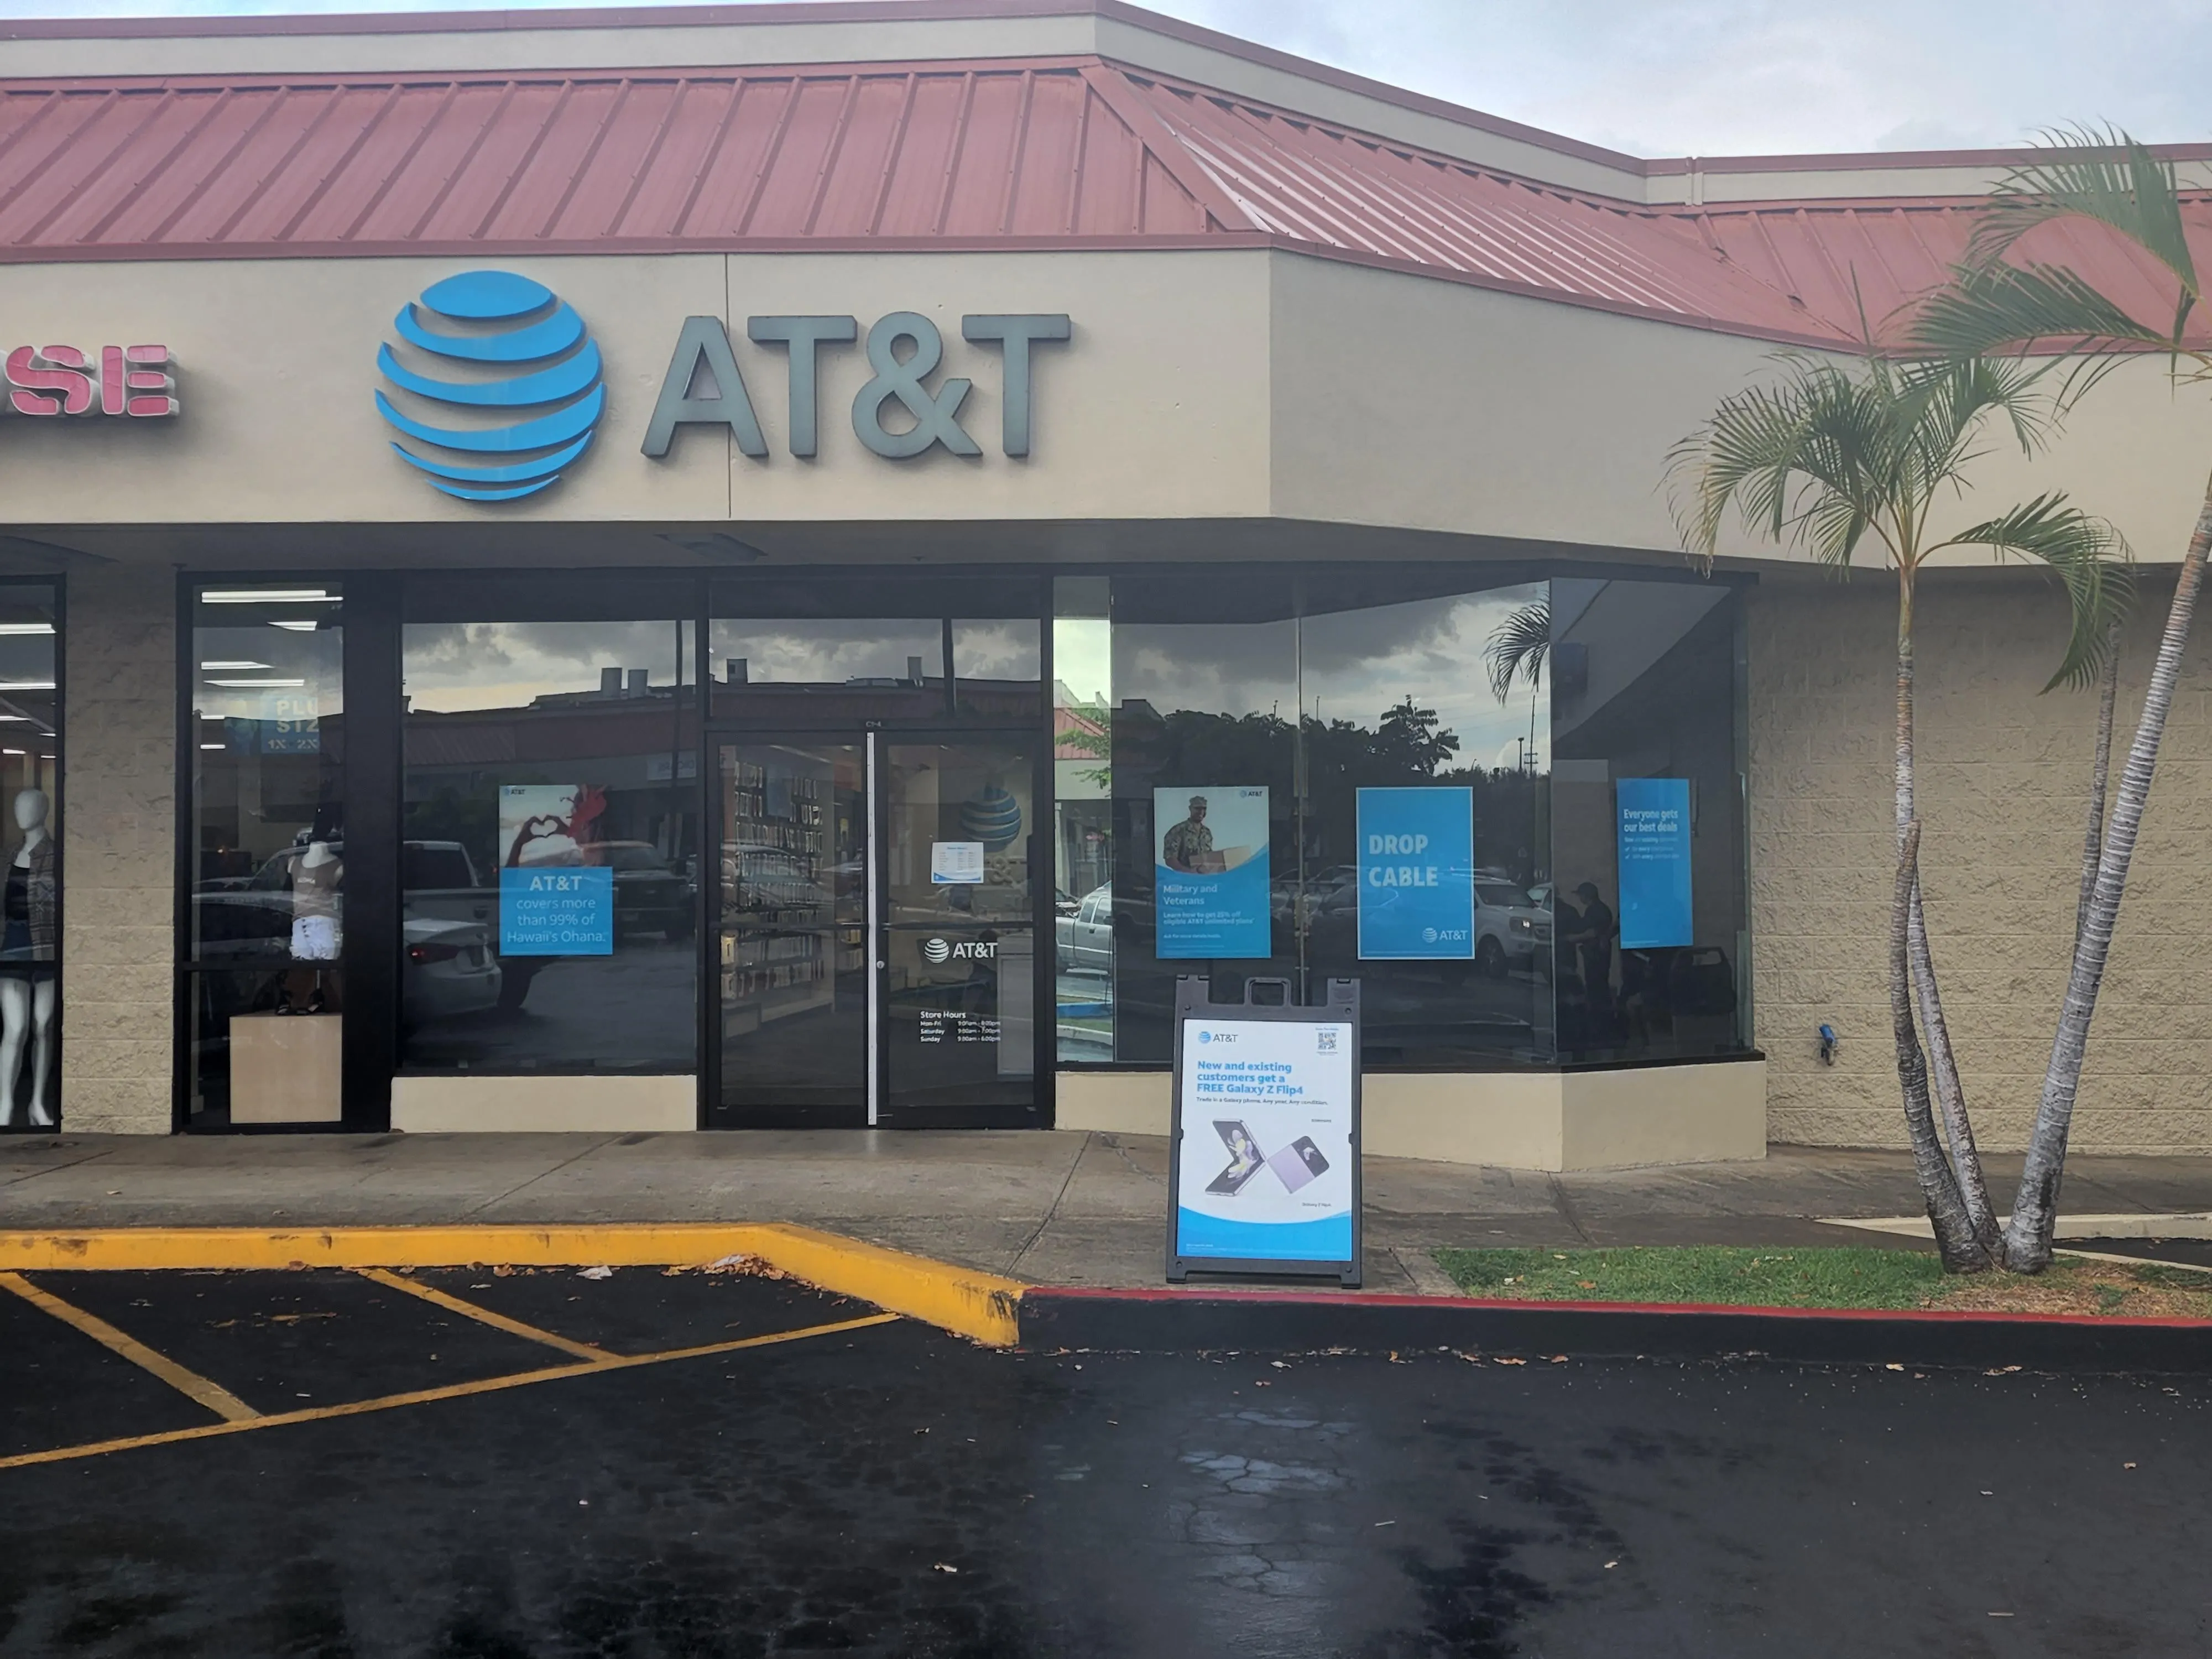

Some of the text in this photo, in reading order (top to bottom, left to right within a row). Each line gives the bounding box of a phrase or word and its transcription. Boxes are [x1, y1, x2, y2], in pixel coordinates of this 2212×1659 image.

[640, 311, 1072, 458] AT&T
[1623, 808, 1678, 822] Everyone gets
[1624, 821, 1678, 832] our best deals
[1369, 834, 1428, 855] DROP
[529, 875, 582, 891] AT&T
[1369, 866, 1439, 888] CABLE
[1163, 884, 1218, 895] Military and
[517, 899, 596, 909] covers more
[1163, 896, 1206, 905] Veterans
[517, 914, 596, 926] than 99% of
[507, 931, 606, 943] Hawaii's Ohana.
[1439, 930, 1468, 941] AT&T
[952, 942, 998, 959] AT&T
[1213, 1033, 1239, 1042] AT&T
[1197, 1061, 1292, 1074] New and existing
[1197, 1073, 1255, 1082] customers
[1258, 1074, 1277, 1084] get
[1197, 1083, 1304, 1097] FREE Galaxy Z Flip4
